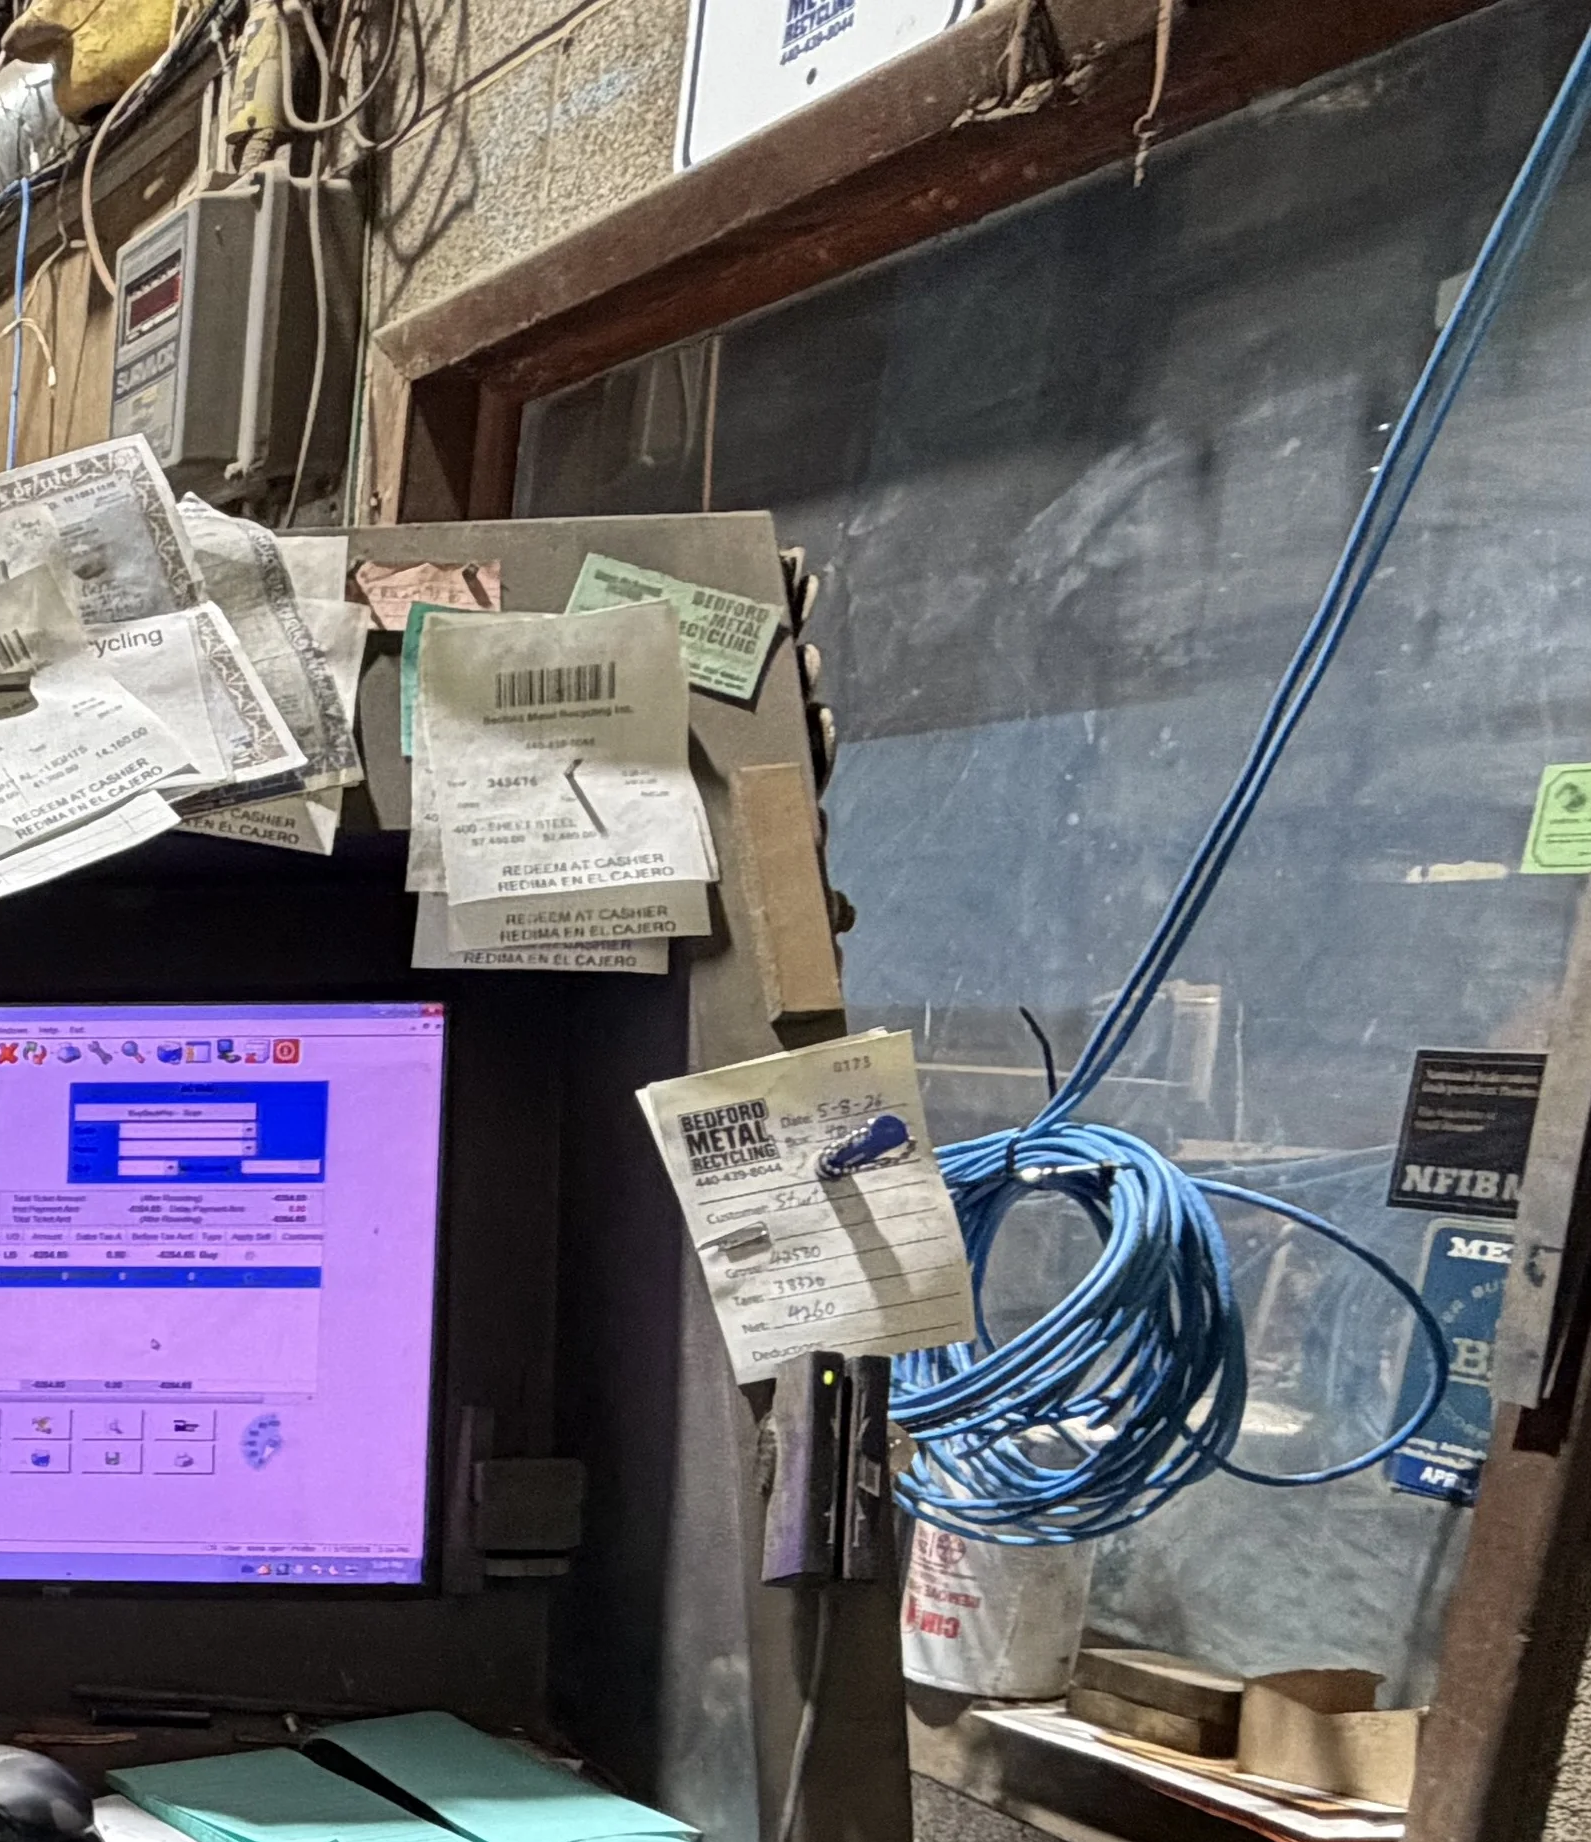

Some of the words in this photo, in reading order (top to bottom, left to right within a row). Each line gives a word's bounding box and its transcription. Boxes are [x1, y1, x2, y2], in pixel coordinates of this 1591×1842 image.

[691, 590, 770, 623] BEDFORD
[679, 620, 758, 655] ECYCLING
[710, 613, 762, 639] METAL
[88, 628, 163, 657] ycling
[12, 797, 69, 825] REDEEM
[69, 789, 87, 803] AT
[89, 757, 149, 793] CASHIER
[14, 811, 68, 839] REDIMA
[90, 795, 107, 807] EL
[107, 765, 163, 799] CAJERO
[192, 819, 215, 830] EN
[219, 821, 234, 833] EL
[239, 824, 300, 845] CAJERO
[230, 807, 296, 829] CASHIER
[502, 862, 568, 876] REDEEM
[570, 859, 590, 872] AT
[594, 853, 665, 870] CASHIER
[498, 878, 558, 893] REDIMA
[561, 876, 583, 887] EN
[588, 873, 608, 884] EL
[610, 866, 675, 882] CAJERO
[506, 911, 571, 926] REDEEM
[575, 909, 593, 922] AT
[598, 905, 668, 921] CASHIER
[500, 929, 560, 943] REDIMA
[564, 927, 585, 939] EN
[589, 926, 608, 937] EL
[611, 920, 676, 935] CAJERO
[463, 951, 525, 964] REDIMA
[529, 952, 549, 965] EN
[553, 954, 571, 965] EL
[575, 954, 637, 967] CAJERO
[680, 1100, 766, 1133] BEDFORD
[685, 1120, 769, 1156] METAL
[692, 1143, 778, 1172] RECYCLING
[1401, 1164, 1500, 1199] NFIB
[1447, 1236, 1515, 1264] ME
